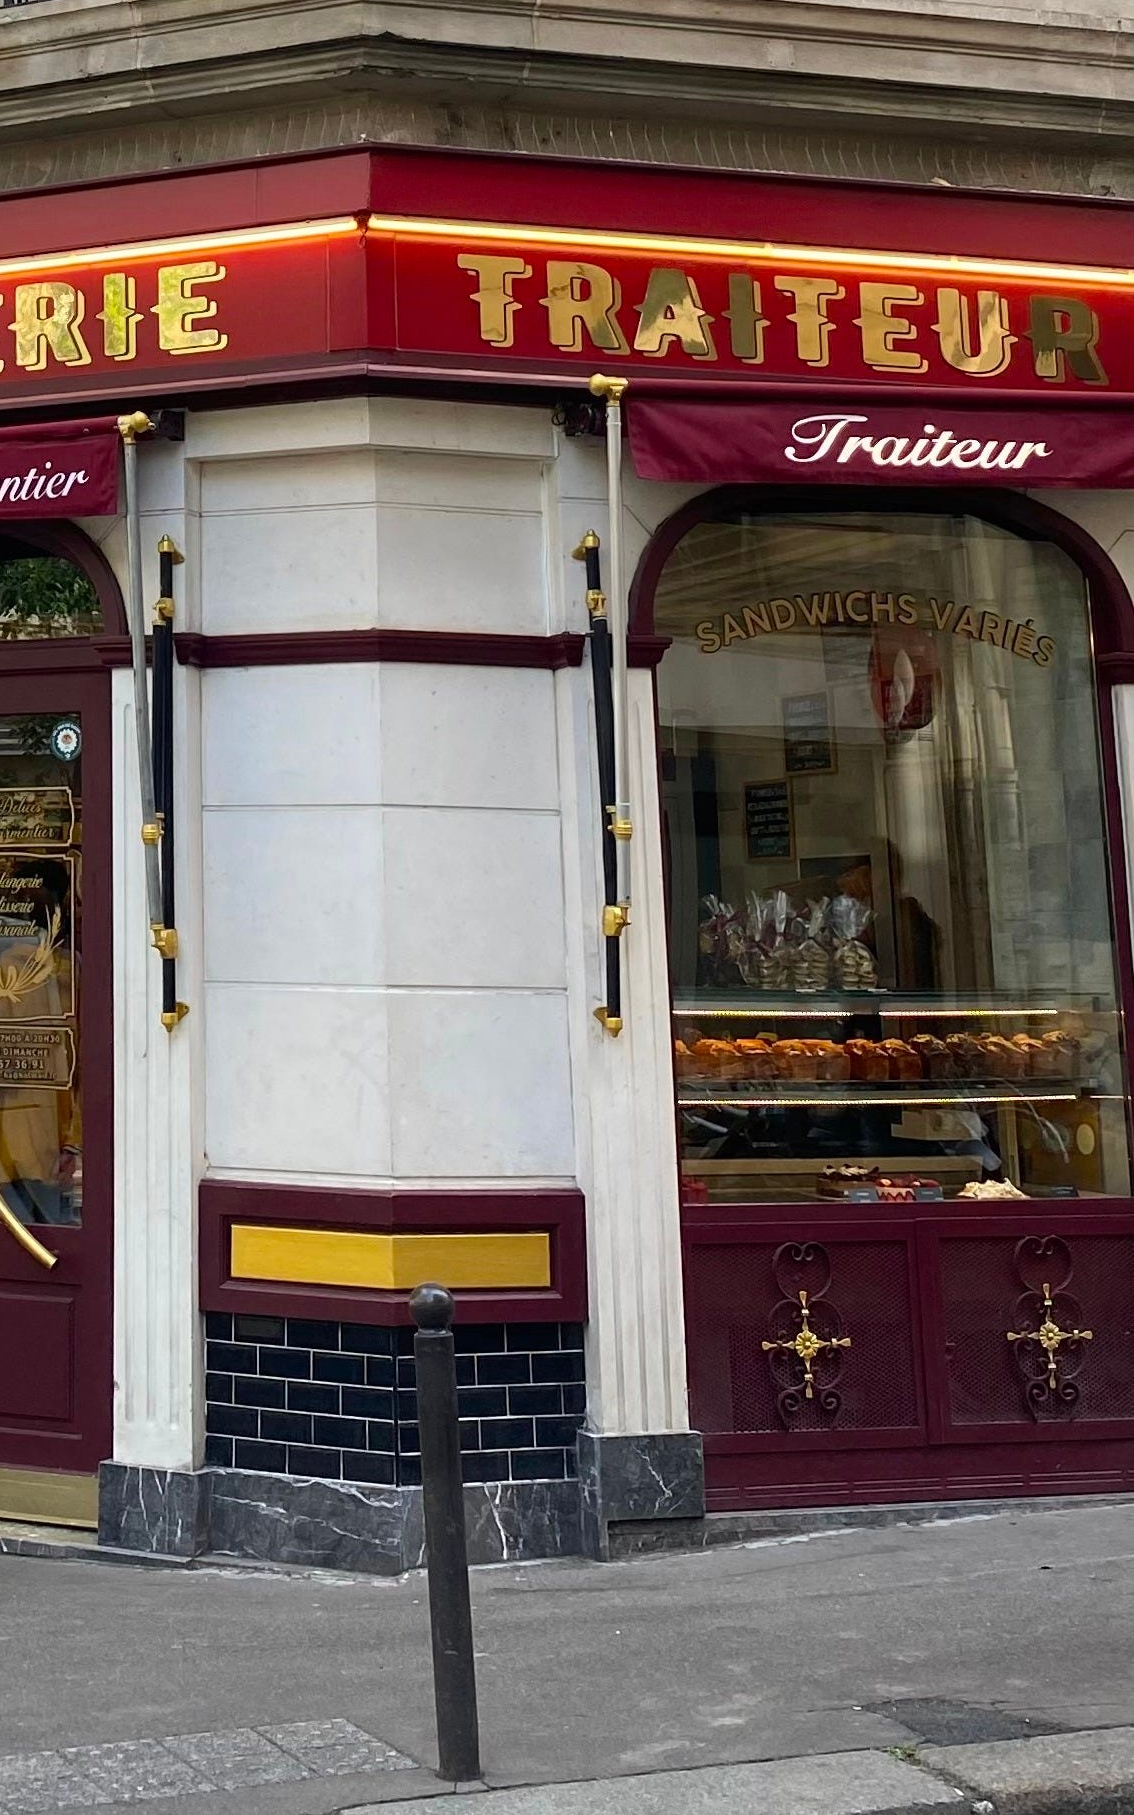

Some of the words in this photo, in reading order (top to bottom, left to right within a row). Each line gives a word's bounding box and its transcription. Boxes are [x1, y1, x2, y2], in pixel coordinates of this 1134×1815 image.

[456, 252, 1110, 386] TRAITEUR
[783, 414, 1054, 470] Traiteur
[695, 590, 918, 655] SANDWICHS
[930, 596, 1058, 669] VARIÉS
[3, 1047, 49, 1058] DIMANCHE
